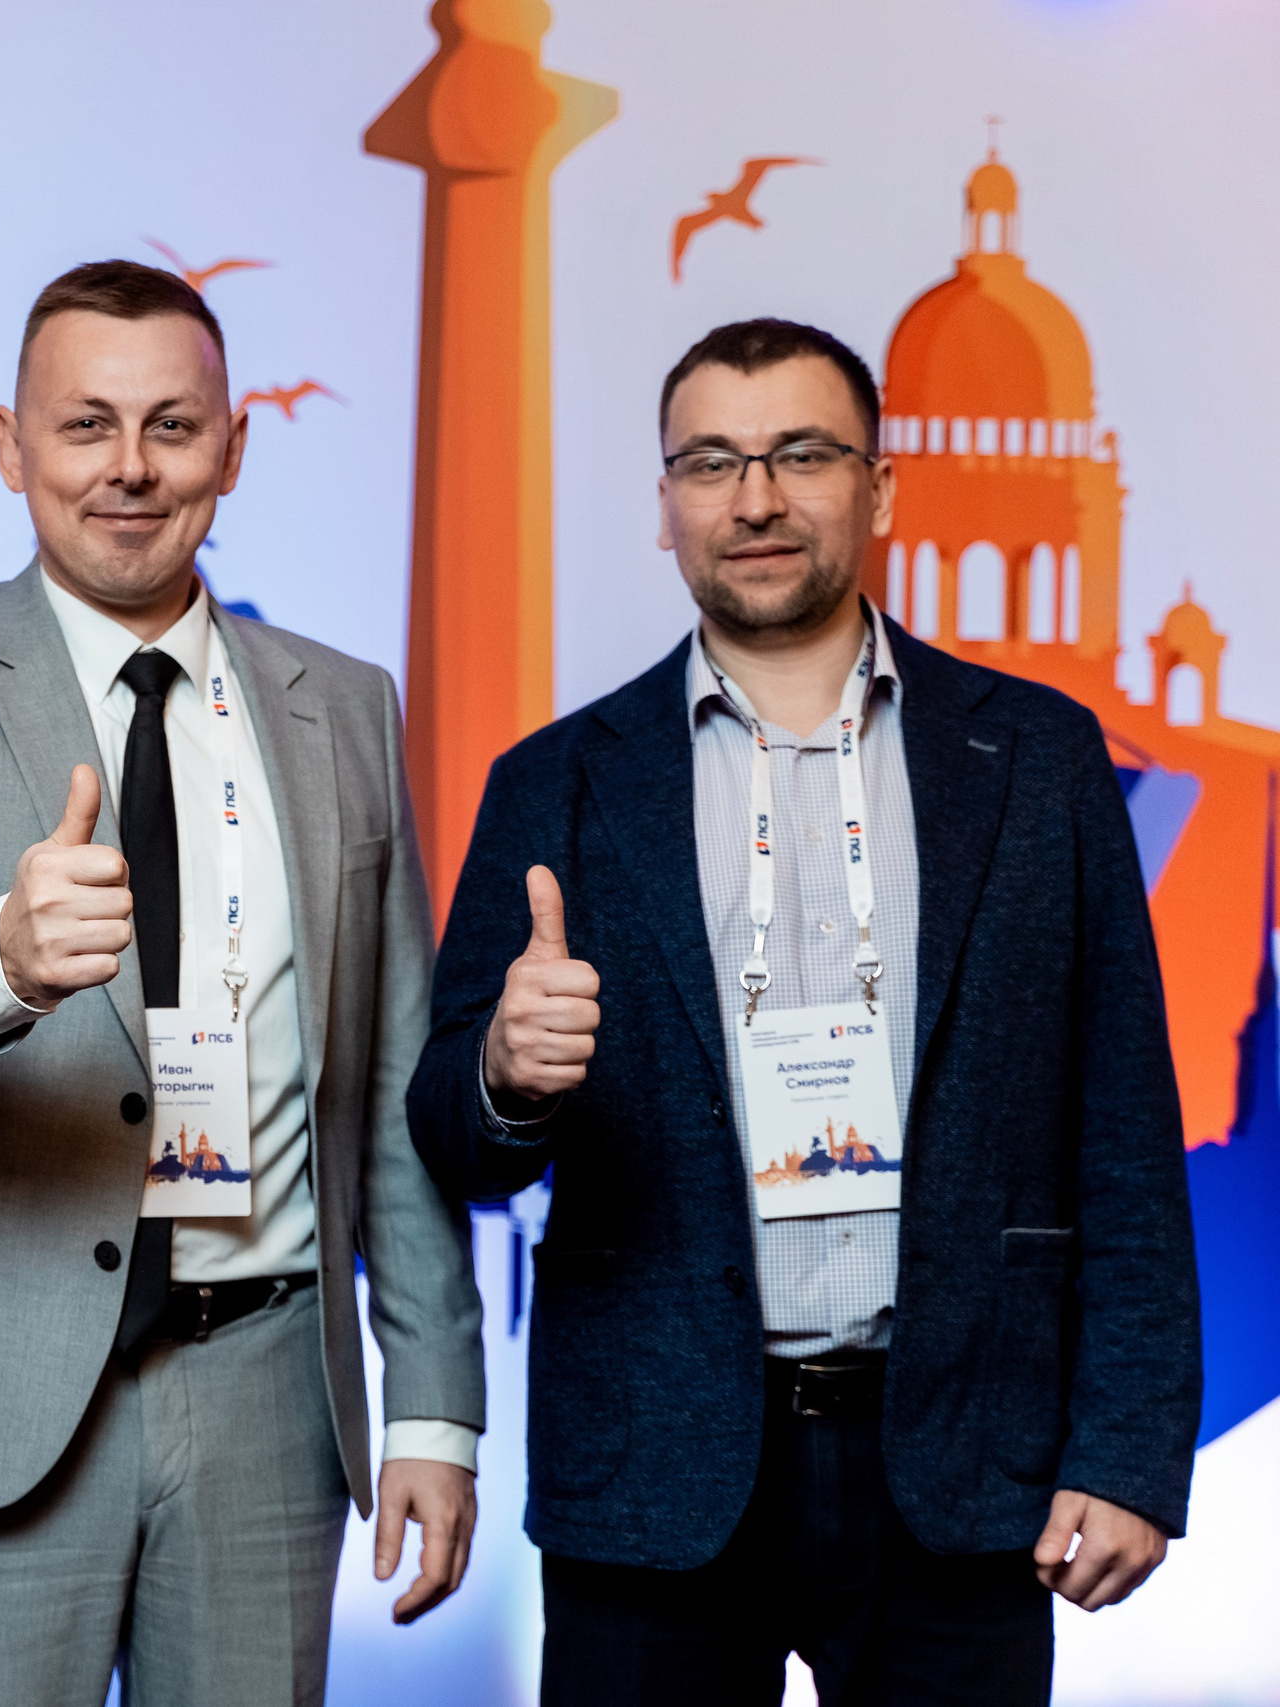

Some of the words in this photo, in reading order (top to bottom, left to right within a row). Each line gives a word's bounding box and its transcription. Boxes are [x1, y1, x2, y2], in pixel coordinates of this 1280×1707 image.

[211, 676, 224, 701] ПСБ
[225, 781, 236, 808] ПСБ
[757, 814, 768, 840] ПСБ
[849, 837, 862, 864] ПСБ
[228, 895, 239, 924] ПСБ
[846, 1024, 874, 1036] ПСБ
[207, 1033, 234, 1044] ПСБ
[158, 1063, 193, 1075] Иван
[776, 1058, 855, 1073] Александр
[151, 1082, 214, 1094] оторыгин
[785, 1075, 850, 1090] Смирнов
